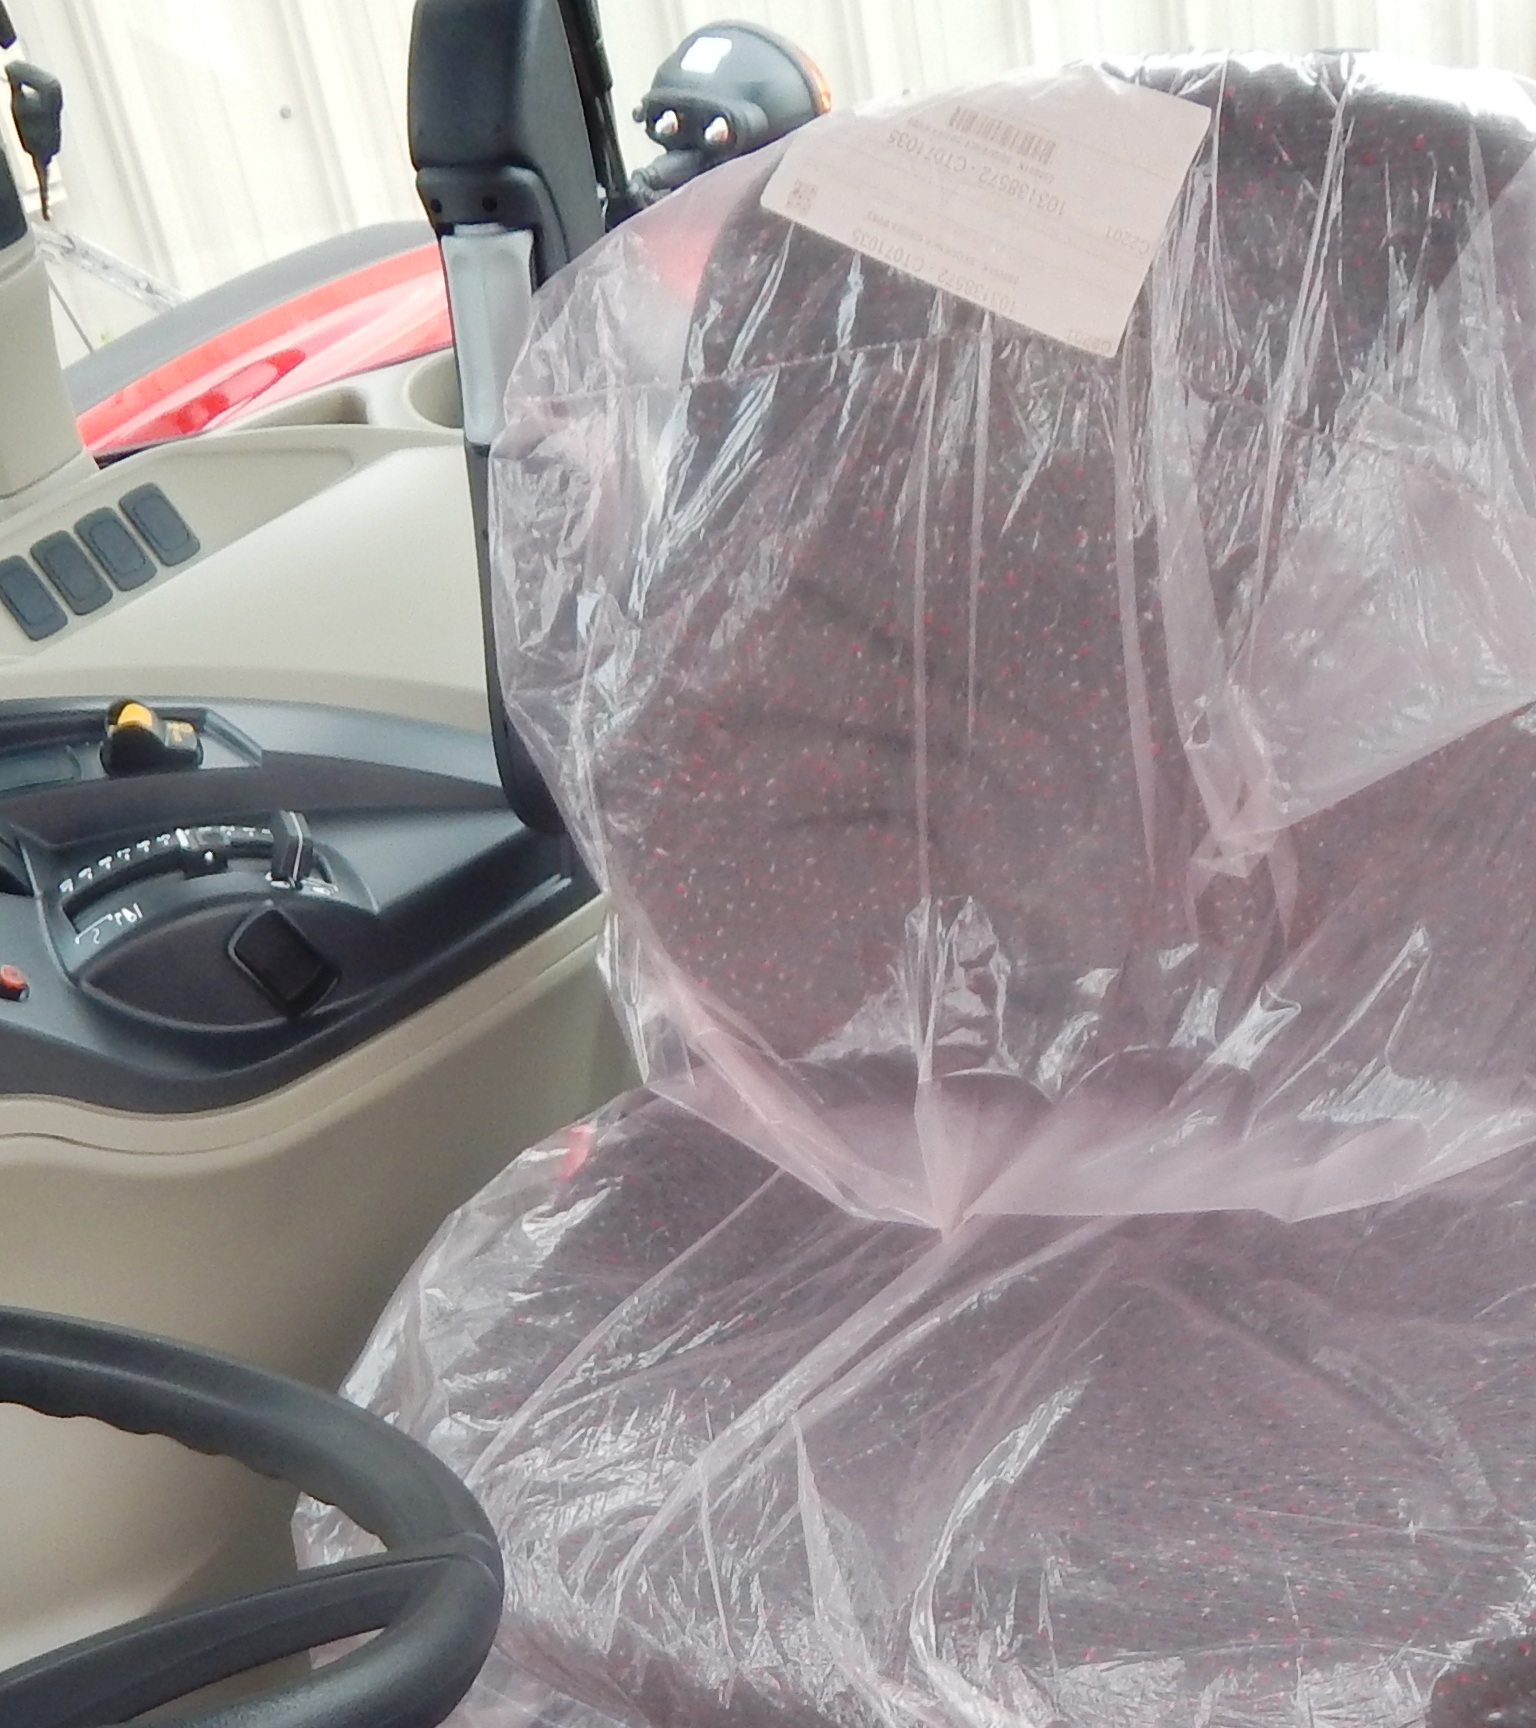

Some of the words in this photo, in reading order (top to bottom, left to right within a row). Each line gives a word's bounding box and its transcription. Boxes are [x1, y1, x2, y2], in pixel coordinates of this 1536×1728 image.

[887, 129, 967, 173] CT071035
[977, 166, 1066, 217] 103138572
[849, 228, 923, 273] CT071035
[1103, 224, 1152, 257] C2201
